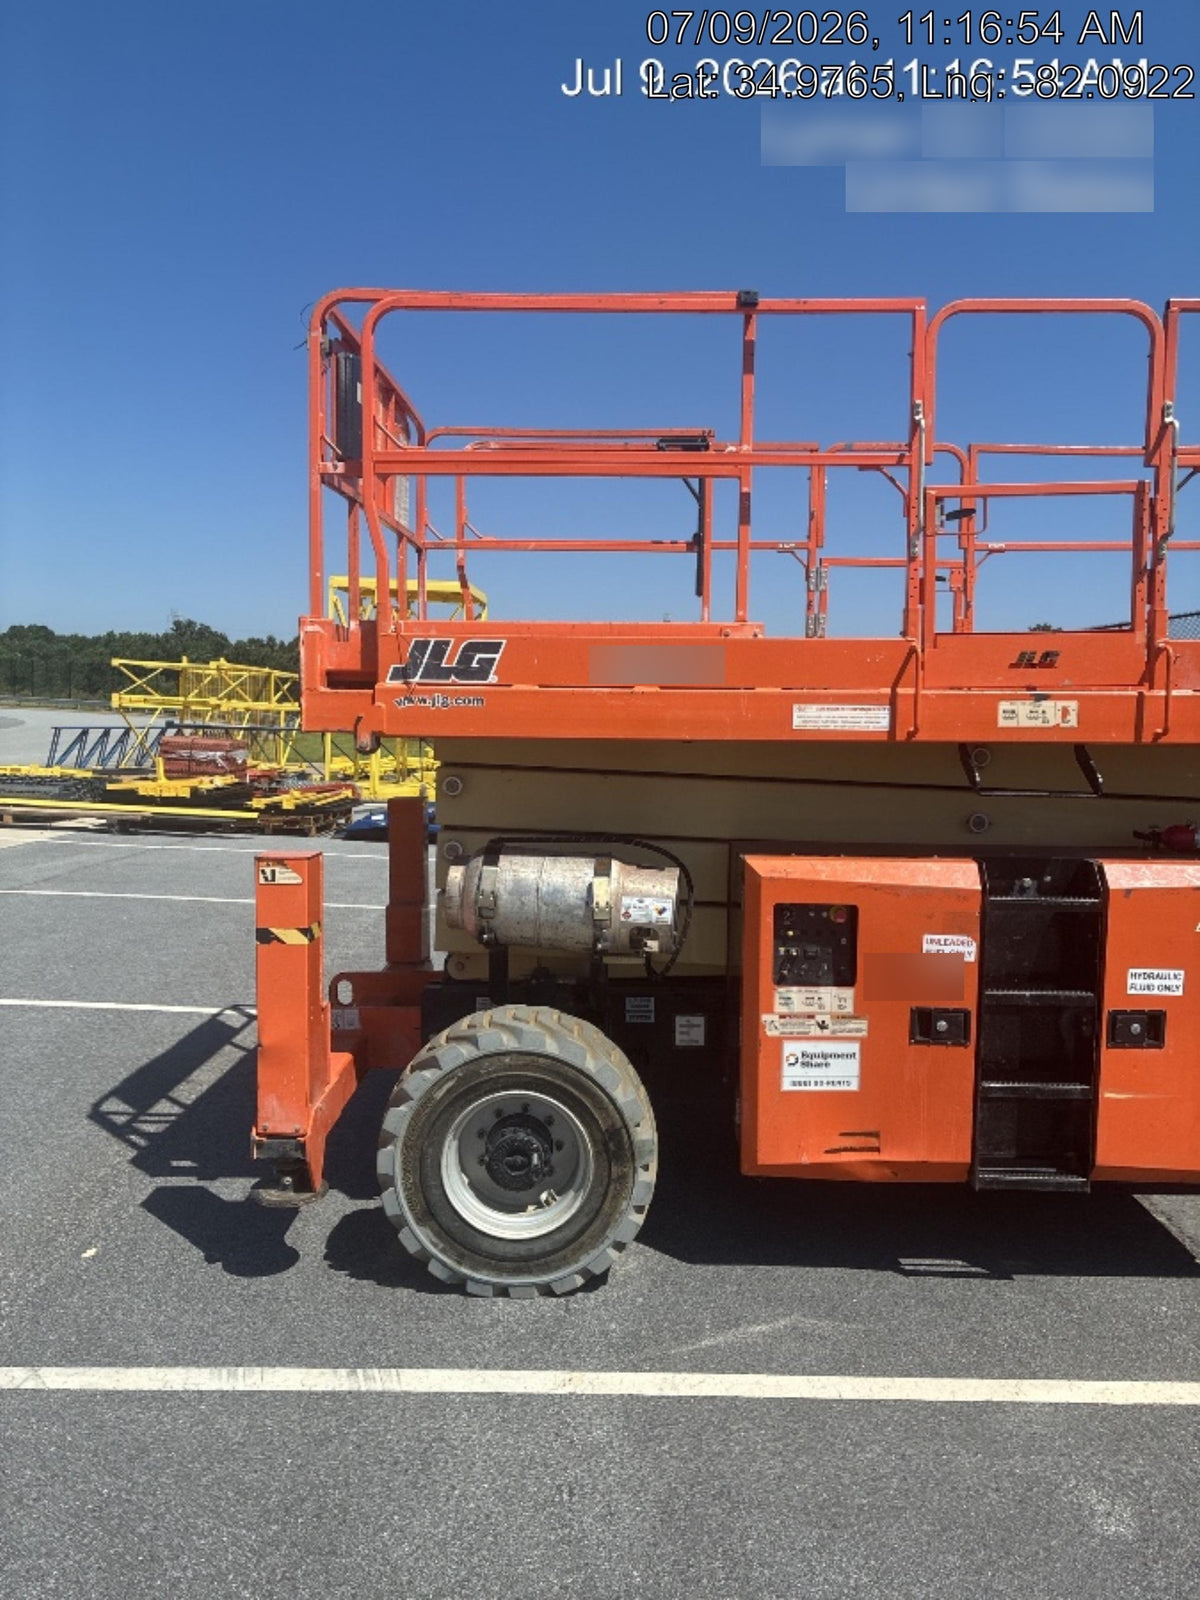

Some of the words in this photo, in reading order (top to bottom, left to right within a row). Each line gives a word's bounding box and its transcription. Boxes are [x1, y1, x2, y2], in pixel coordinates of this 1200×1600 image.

[385, 637, 507, 684] JLG
[1008, 649, 1060, 670] JLG
[394, 692, 485, 709] www.jlg.com
